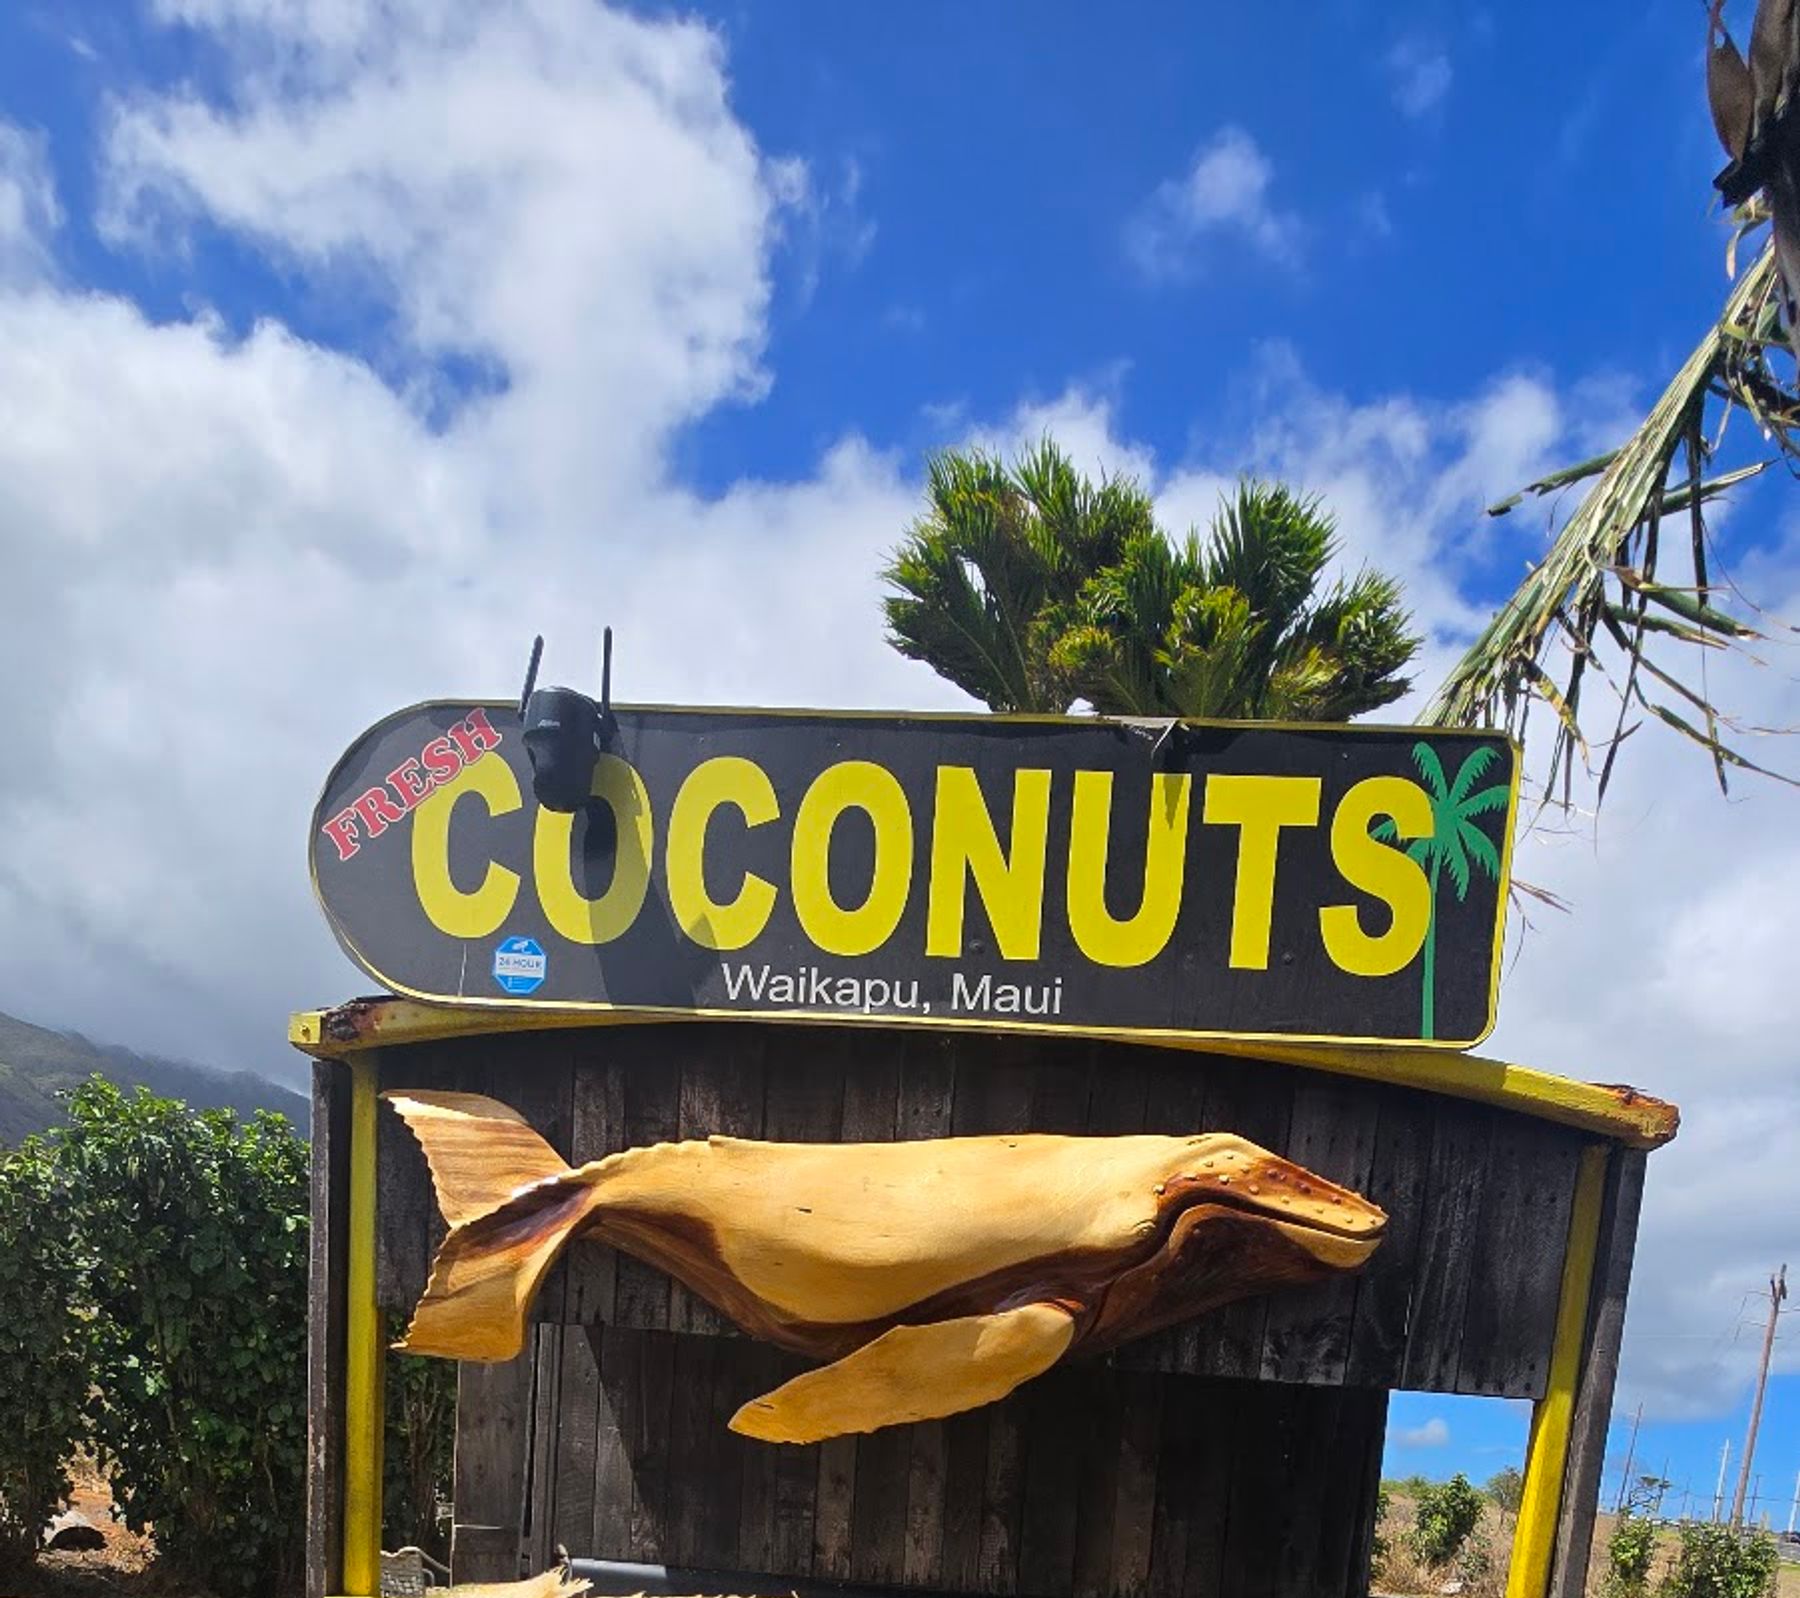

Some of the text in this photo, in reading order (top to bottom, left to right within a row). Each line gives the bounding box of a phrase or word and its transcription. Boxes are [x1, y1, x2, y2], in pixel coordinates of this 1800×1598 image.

[322, 707, 502, 861] FRESH
[411, 750, 1435, 977] COCONUTS
[721, 962, 1063, 1015] Waikapu, Maui
